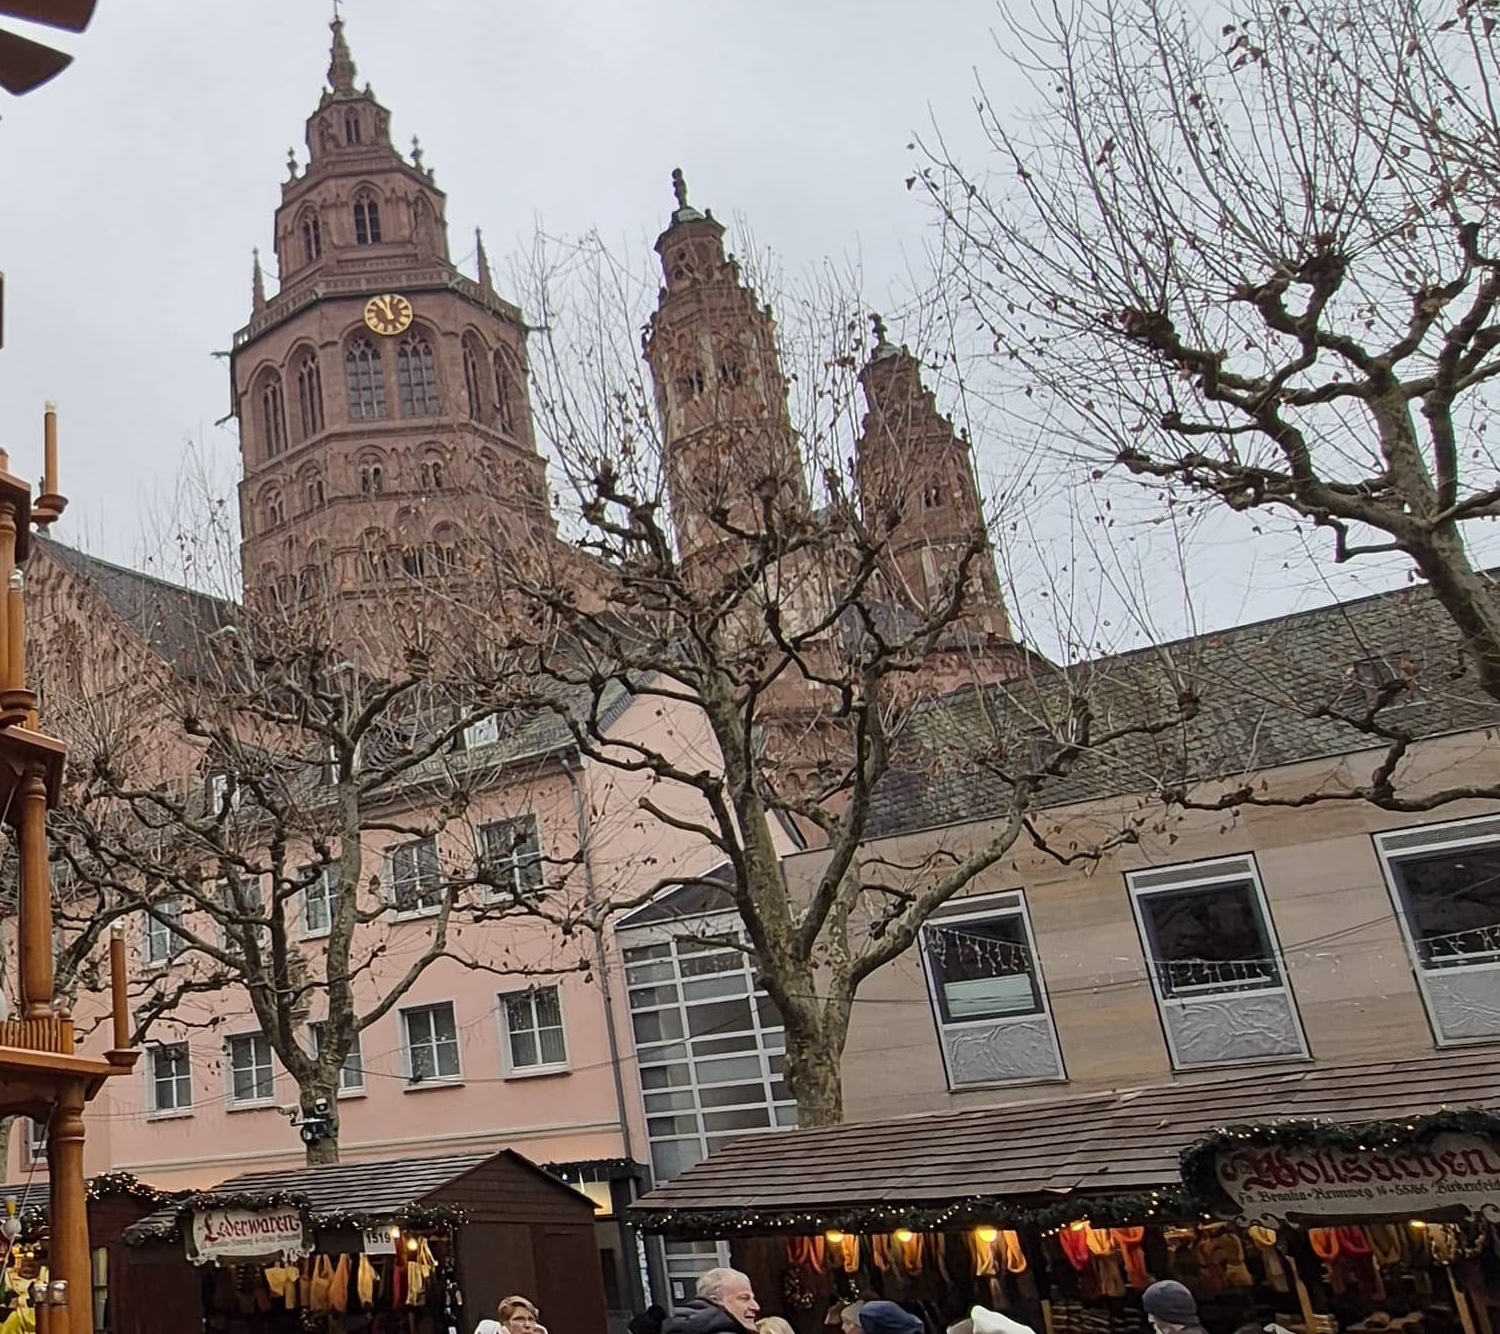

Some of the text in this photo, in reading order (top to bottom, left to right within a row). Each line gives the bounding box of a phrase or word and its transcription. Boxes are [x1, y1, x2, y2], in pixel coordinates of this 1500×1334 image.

[1222, 1147, 1500, 1192] Wollsachen
[203, 1211, 300, 1243] Lederwaren
[367, 1231, 391, 1244] 1519
